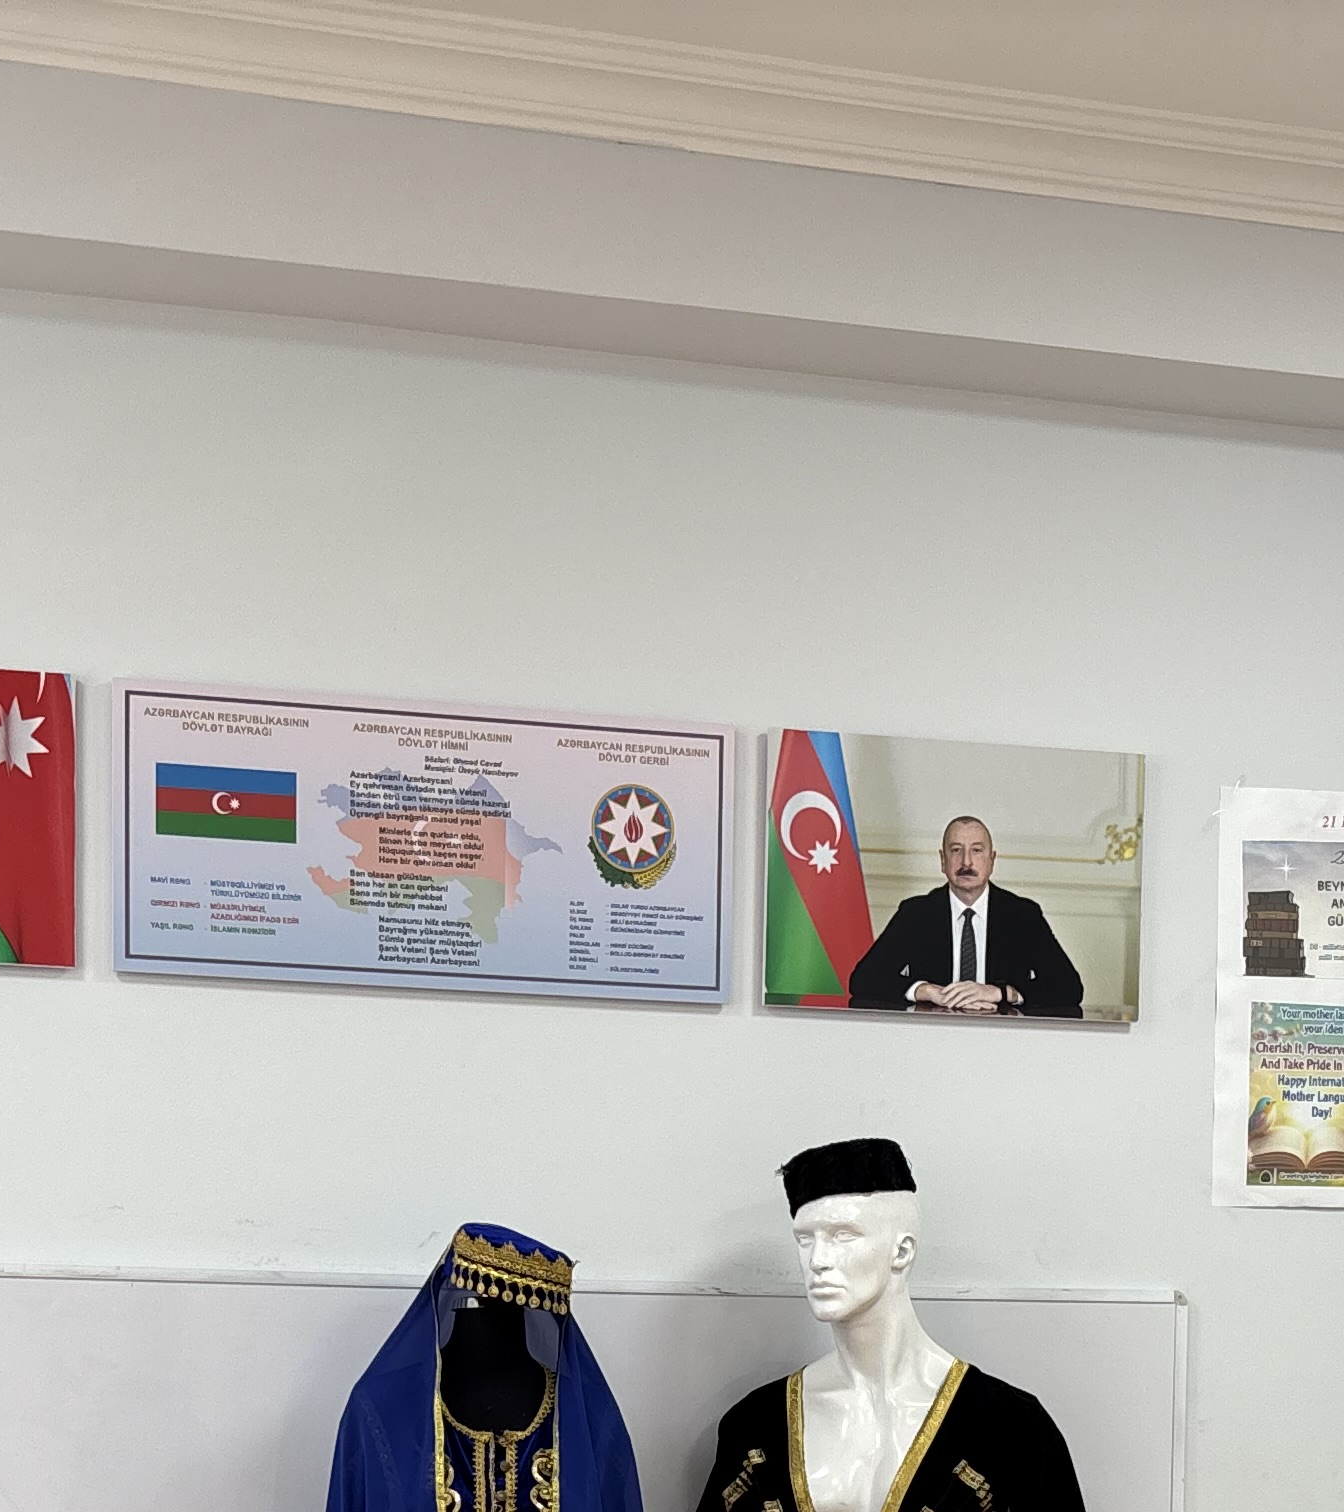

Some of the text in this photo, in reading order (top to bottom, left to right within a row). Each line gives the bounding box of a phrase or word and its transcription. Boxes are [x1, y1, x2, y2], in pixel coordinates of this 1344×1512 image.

[1322, 815, 1336, 828] 21
[1281, 1008, 1301, 1018] Your
[1303, 1009, 1334, 1020] mother
[1304, 1026, 1323, 1036] your
[1256, 1043, 1291, 1053] Cherish
[1260, 1058, 1280, 1069] And
[1283, 1059, 1304, 1069] Take
[1307, 1059, 1331, 1070] Pride
[1334, 1061, 1342, 1071] In
[1278, 1075, 1306, 1088] Happy
[1282, 1090, 1315, 1102] Mother
[1312, 1107, 1332, 1119] Day!
